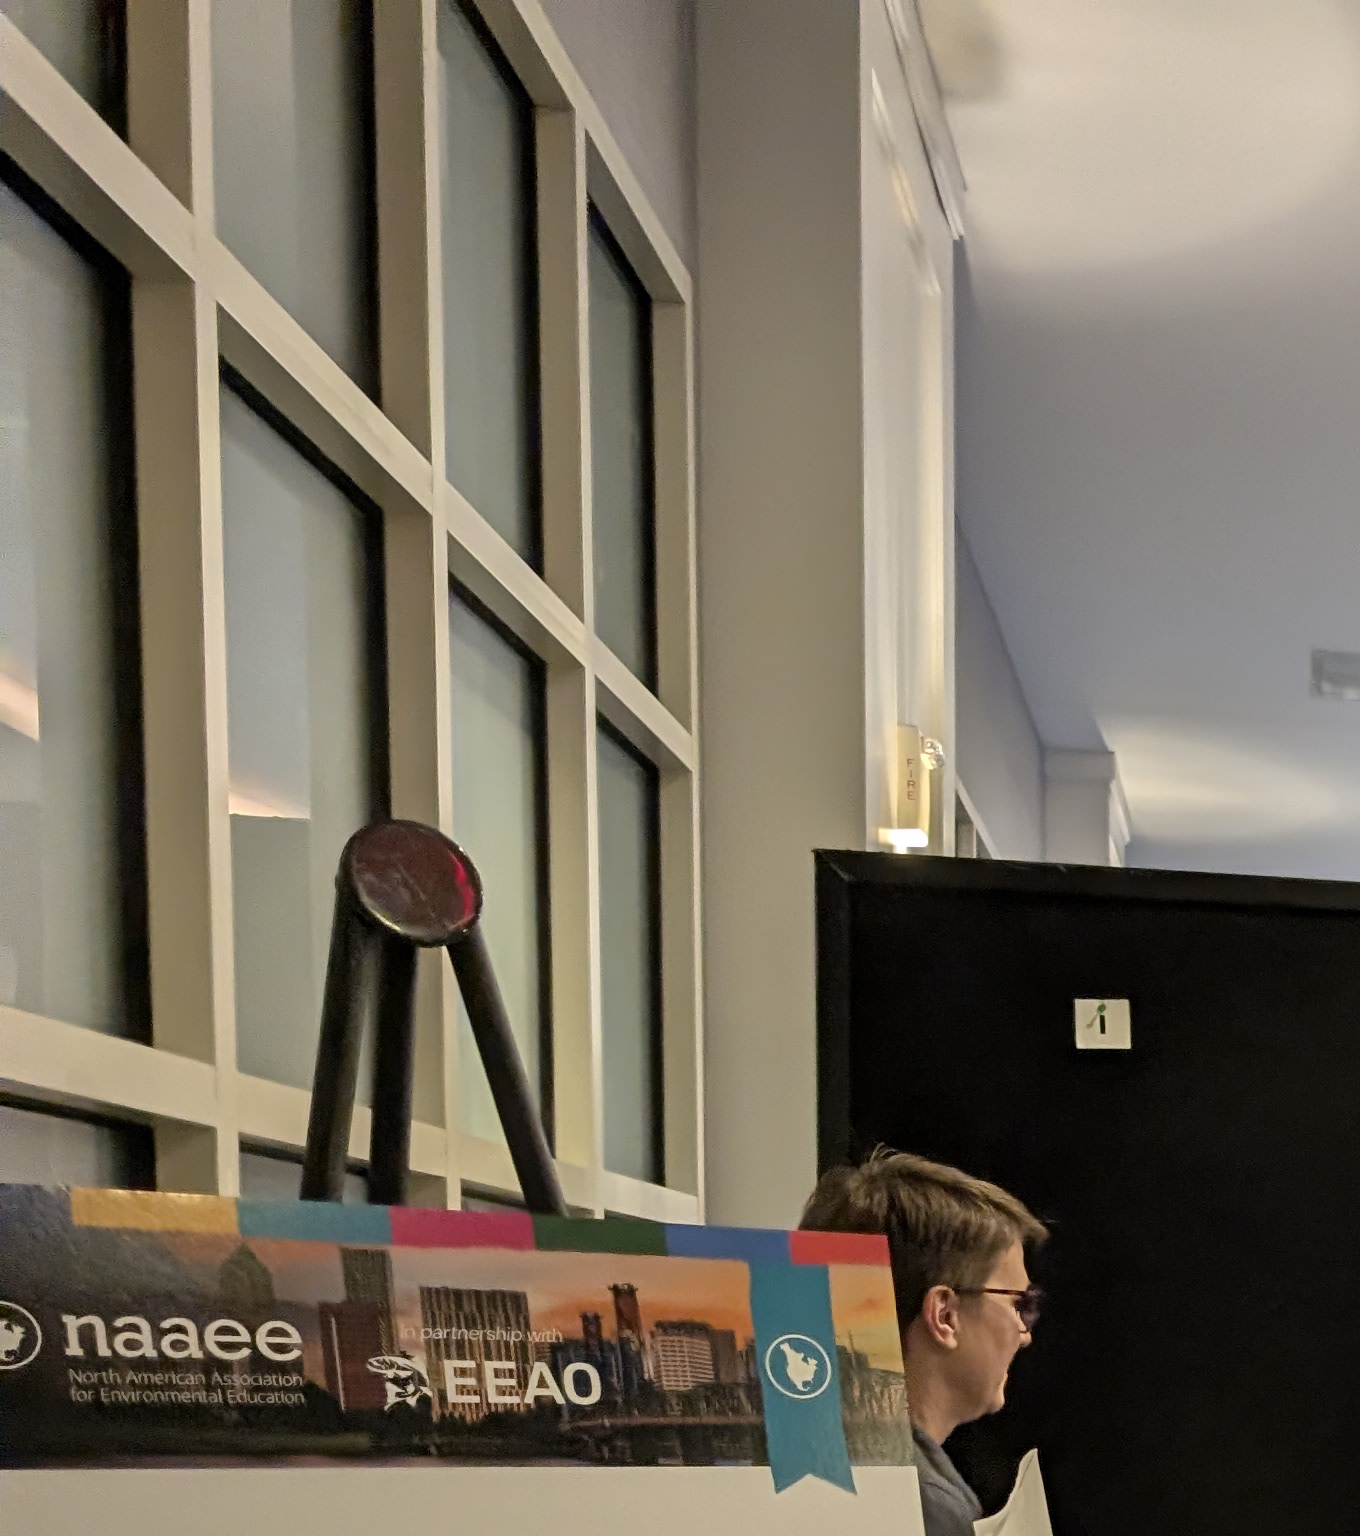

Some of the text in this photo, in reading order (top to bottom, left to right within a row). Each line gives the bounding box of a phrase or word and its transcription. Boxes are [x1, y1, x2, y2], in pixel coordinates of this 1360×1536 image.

[906, 758, 916, 801] FIRE
[61, 1314, 302, 1361] naaee
[400, 1325, 562, 1342] In partnership with
[70, 1369, 302, 1387] North American Association
[444, 1360, 601, 1405] EEAO
[71, 1386, 305, 1405] for Environmental Education
